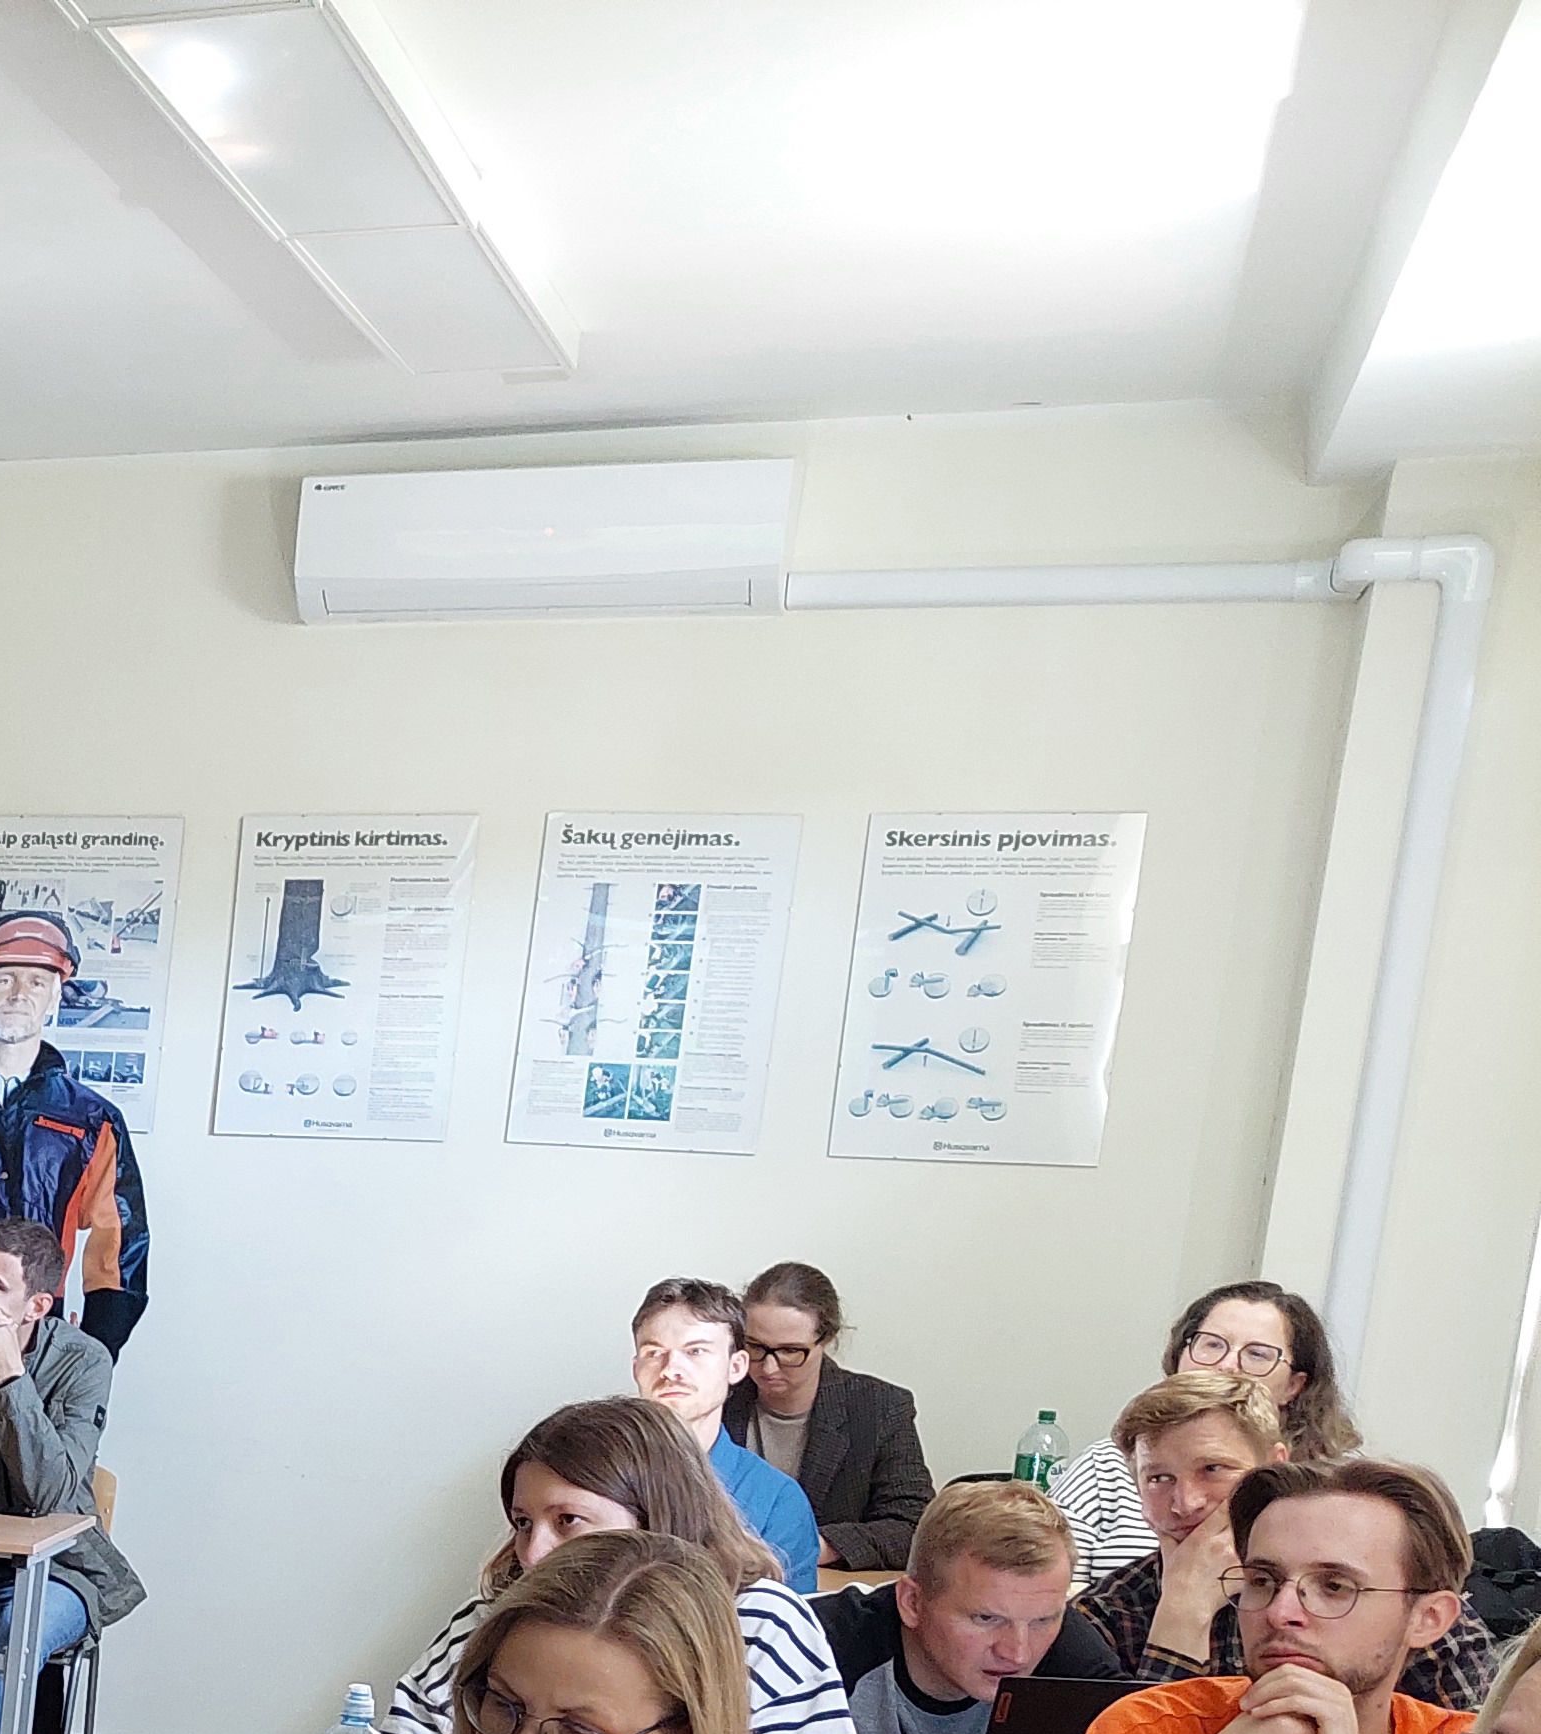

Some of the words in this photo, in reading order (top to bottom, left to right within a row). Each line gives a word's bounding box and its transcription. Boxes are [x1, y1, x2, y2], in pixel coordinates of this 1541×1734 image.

[20, 831, 78, 850] galąsti
[80, 832, 165, 851] grandinę.
[255, 830, 351, 852] Kryptinis
[354, 830, 448, 847] kirtimas.
[560, 823, 616, 850] Šakų
[619, 828, 741, 851] genėjimas.
[884, 829, 992, 848] Skersinis
[997, 829, 1117, 852] pjovimas.
